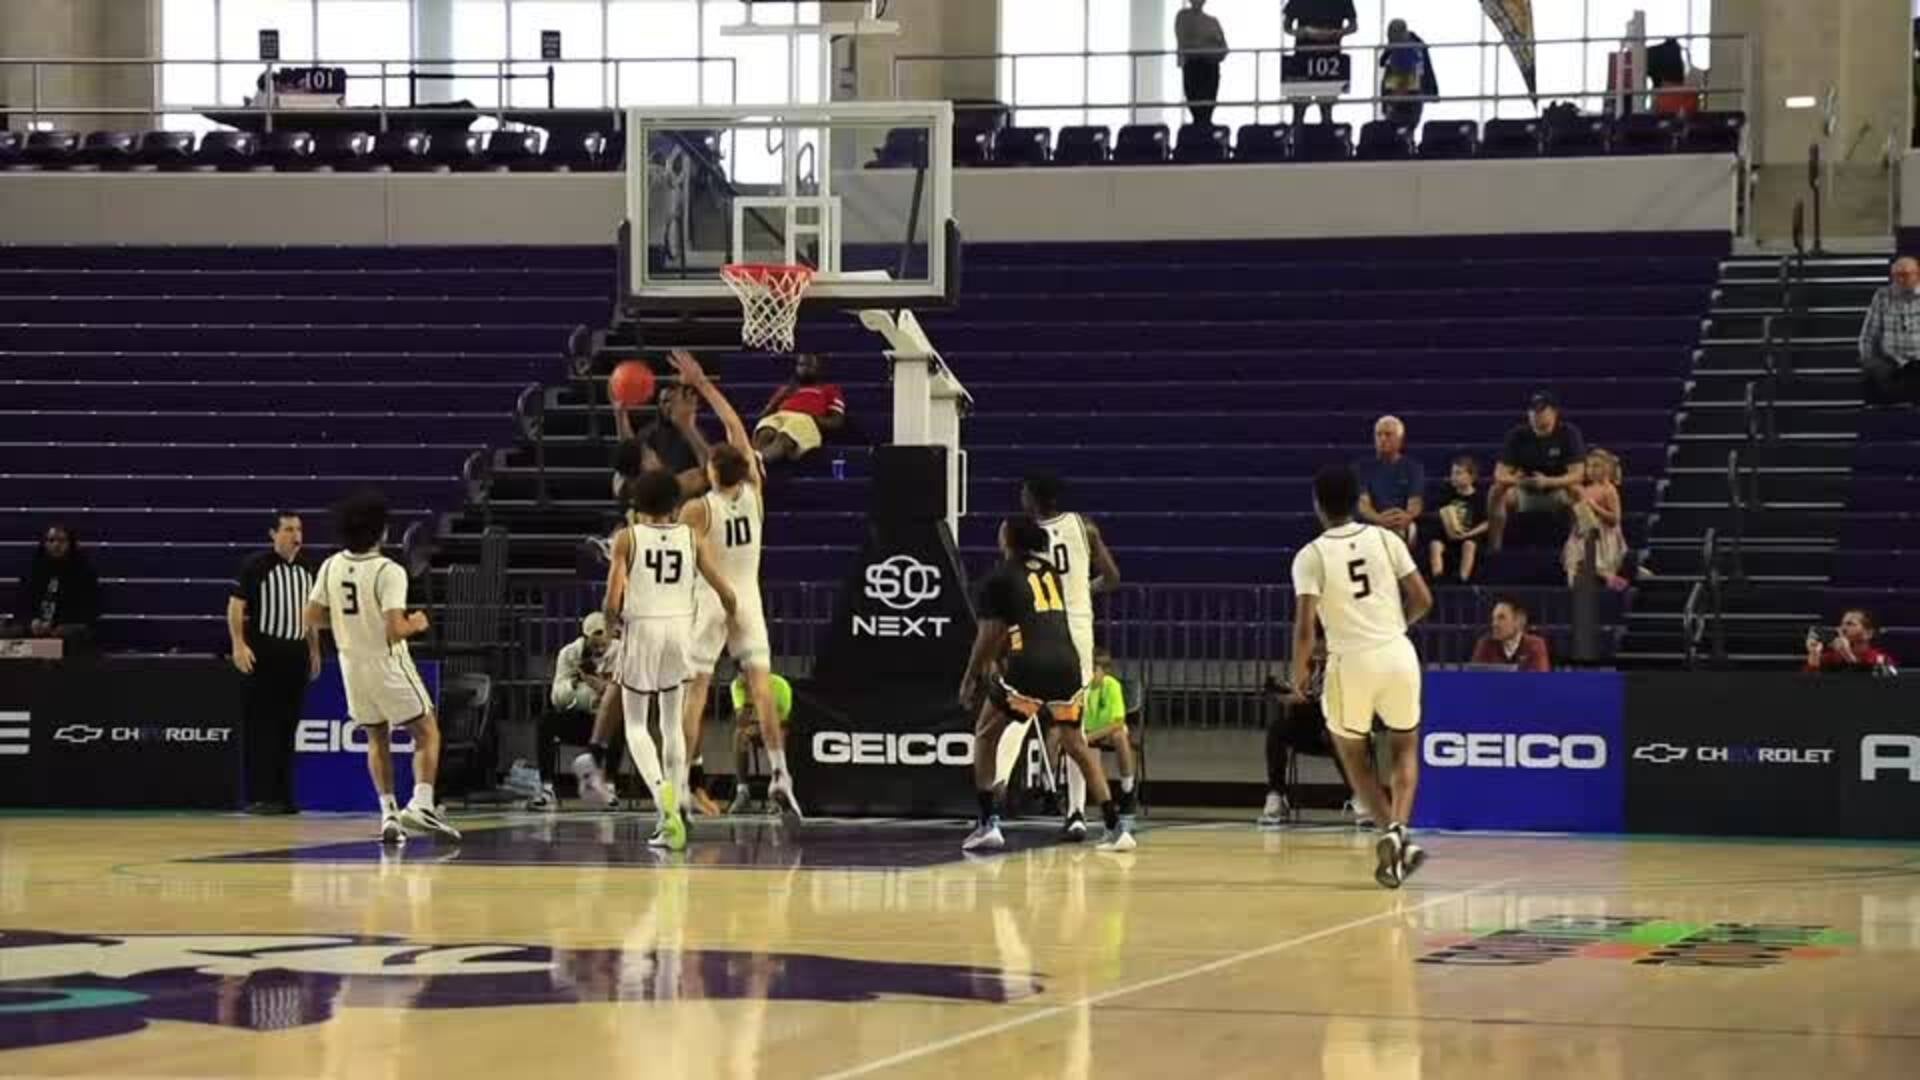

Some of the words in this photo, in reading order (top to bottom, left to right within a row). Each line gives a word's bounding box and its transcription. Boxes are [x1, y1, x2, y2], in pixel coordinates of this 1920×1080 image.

[1307, 57, 1340, 76] 102
[725, 516, 752, 548] 10
[645, 548, 682, 583] 43
[1347, 558, 1371, 600] 5
[341, 581, 358, 615] 3
[1027, 571, 1063, 613] 11
[852, 615, 951, 637] NEXT
[111, 726, 232, 741] CHROLET
[812, 731, 975, 765] GEICO
[1423, 732, 1607, 769] GEICO
